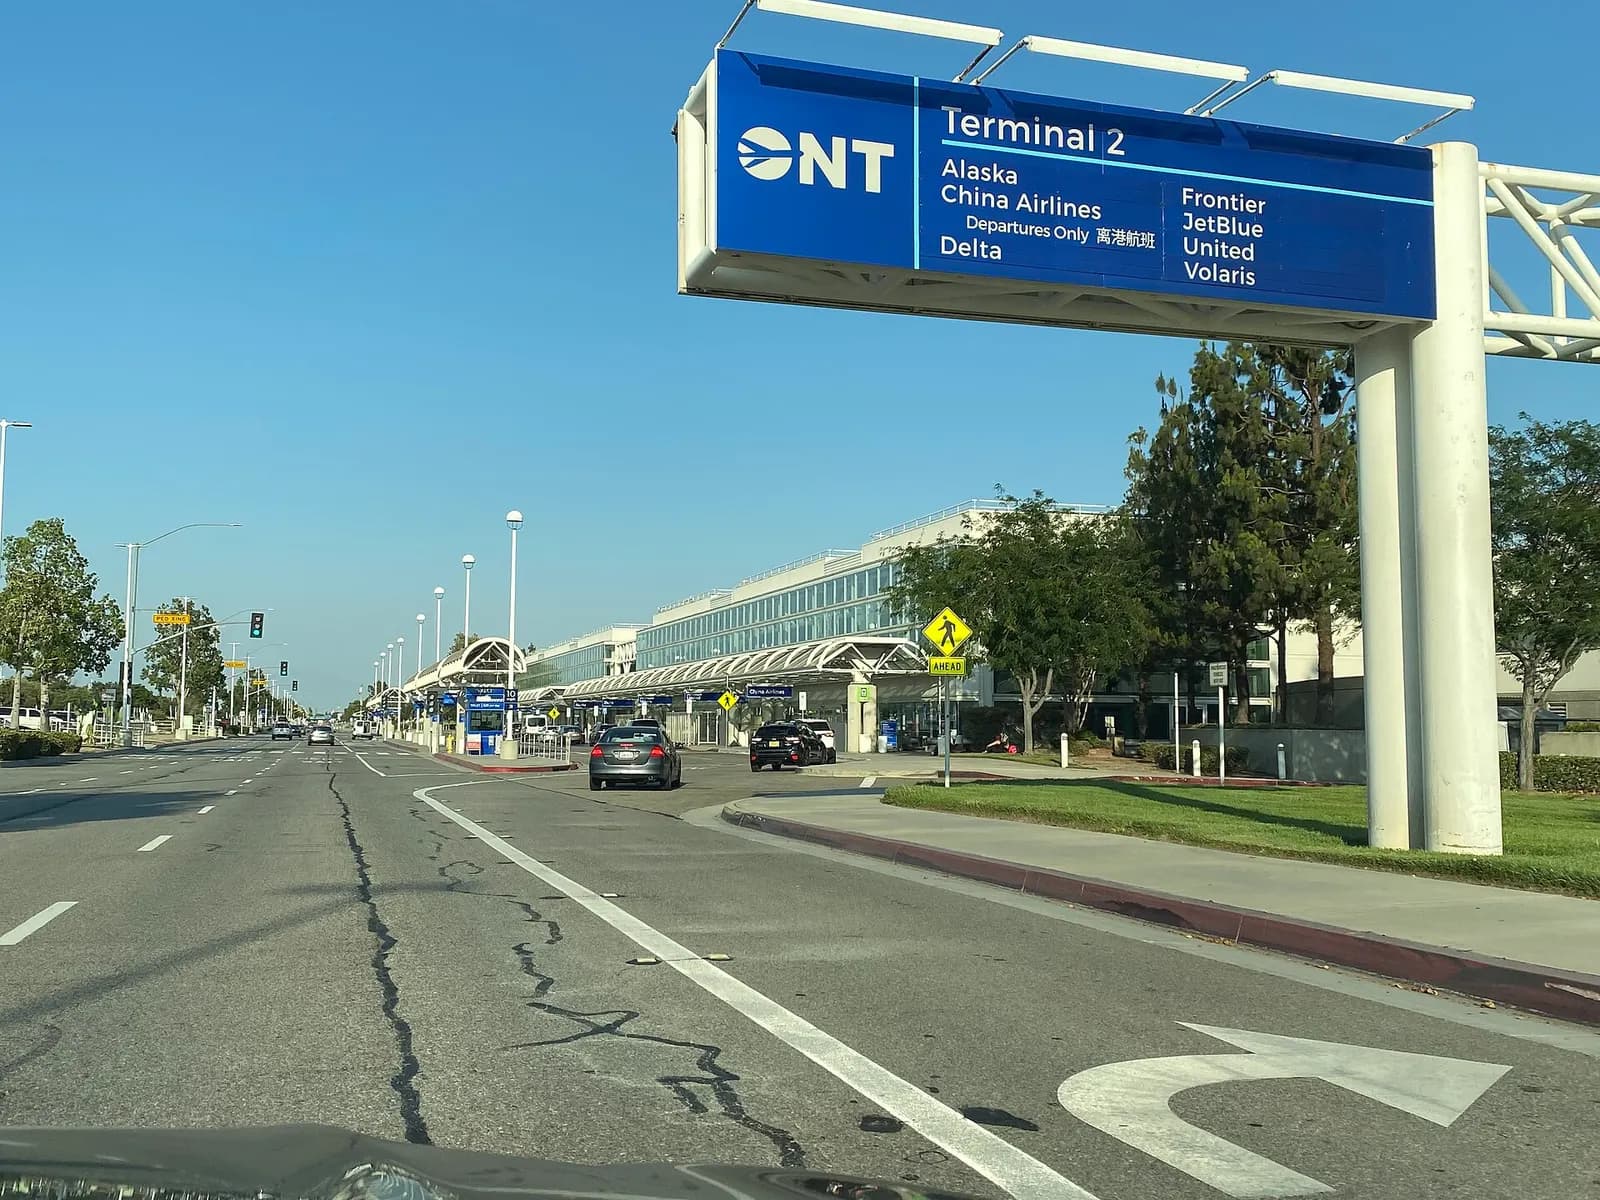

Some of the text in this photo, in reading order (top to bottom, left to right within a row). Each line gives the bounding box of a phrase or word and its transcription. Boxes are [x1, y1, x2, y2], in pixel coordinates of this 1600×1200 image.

[941, 106, 1126, 156] Terminal 2
[737, 126, 895, 194] ONT
[941, 158, 1018, 185] Alaska
[941, 184, 1102, 220] China Airlines
[1182, 187, 1266, 214] Frontier
[966, 215, 1156, 249] Departures Only 离港航班
[1182, 212, 1264, 238] JetBlue
[940, 235, 1002, 260] Delta
[1183, 236, 1255, 262] United
[1183, 261, 1256, 286] Volaris
[934, 662, 961, 671] AHEAD
[506, 690, 516, 698] 10
